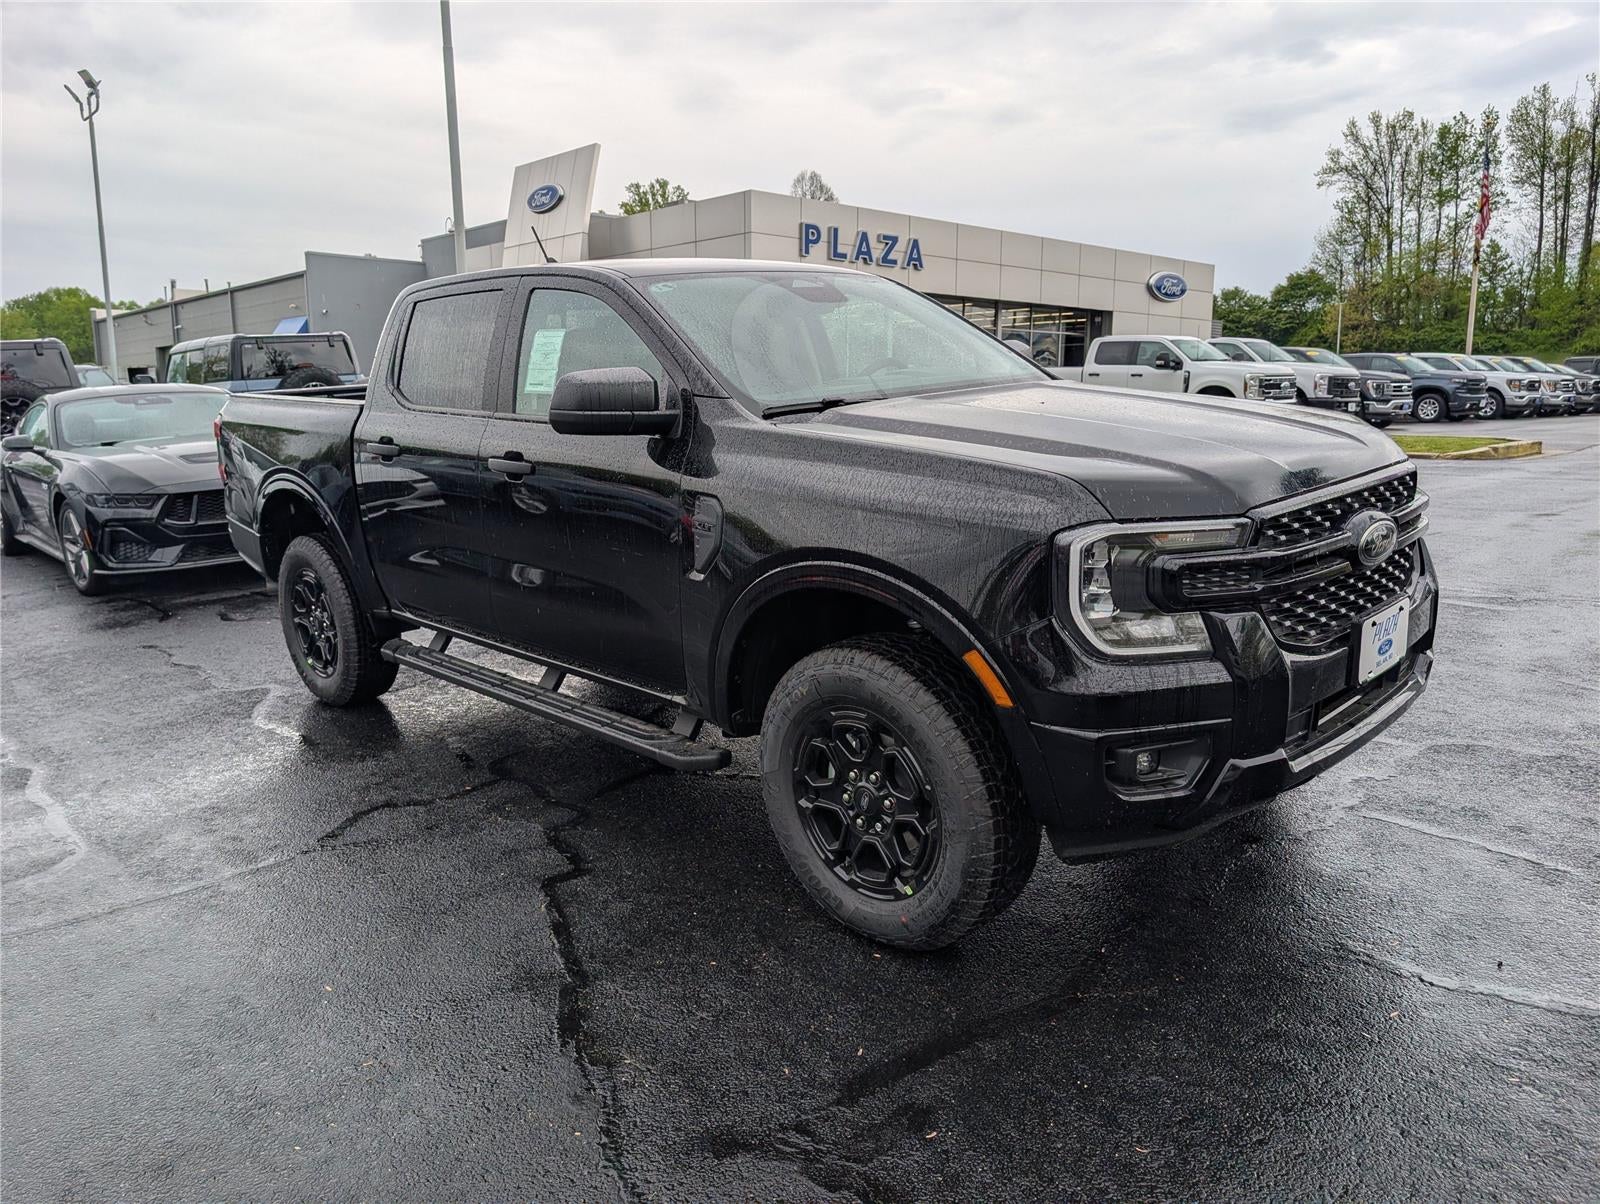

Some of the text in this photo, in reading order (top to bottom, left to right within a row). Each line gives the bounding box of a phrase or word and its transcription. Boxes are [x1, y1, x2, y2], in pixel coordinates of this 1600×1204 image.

[801, 222, 924, 270] PLAZA
[1161, 277, 1183, 295] Ford
[1372, 612, 1400, 645] PLAZA
